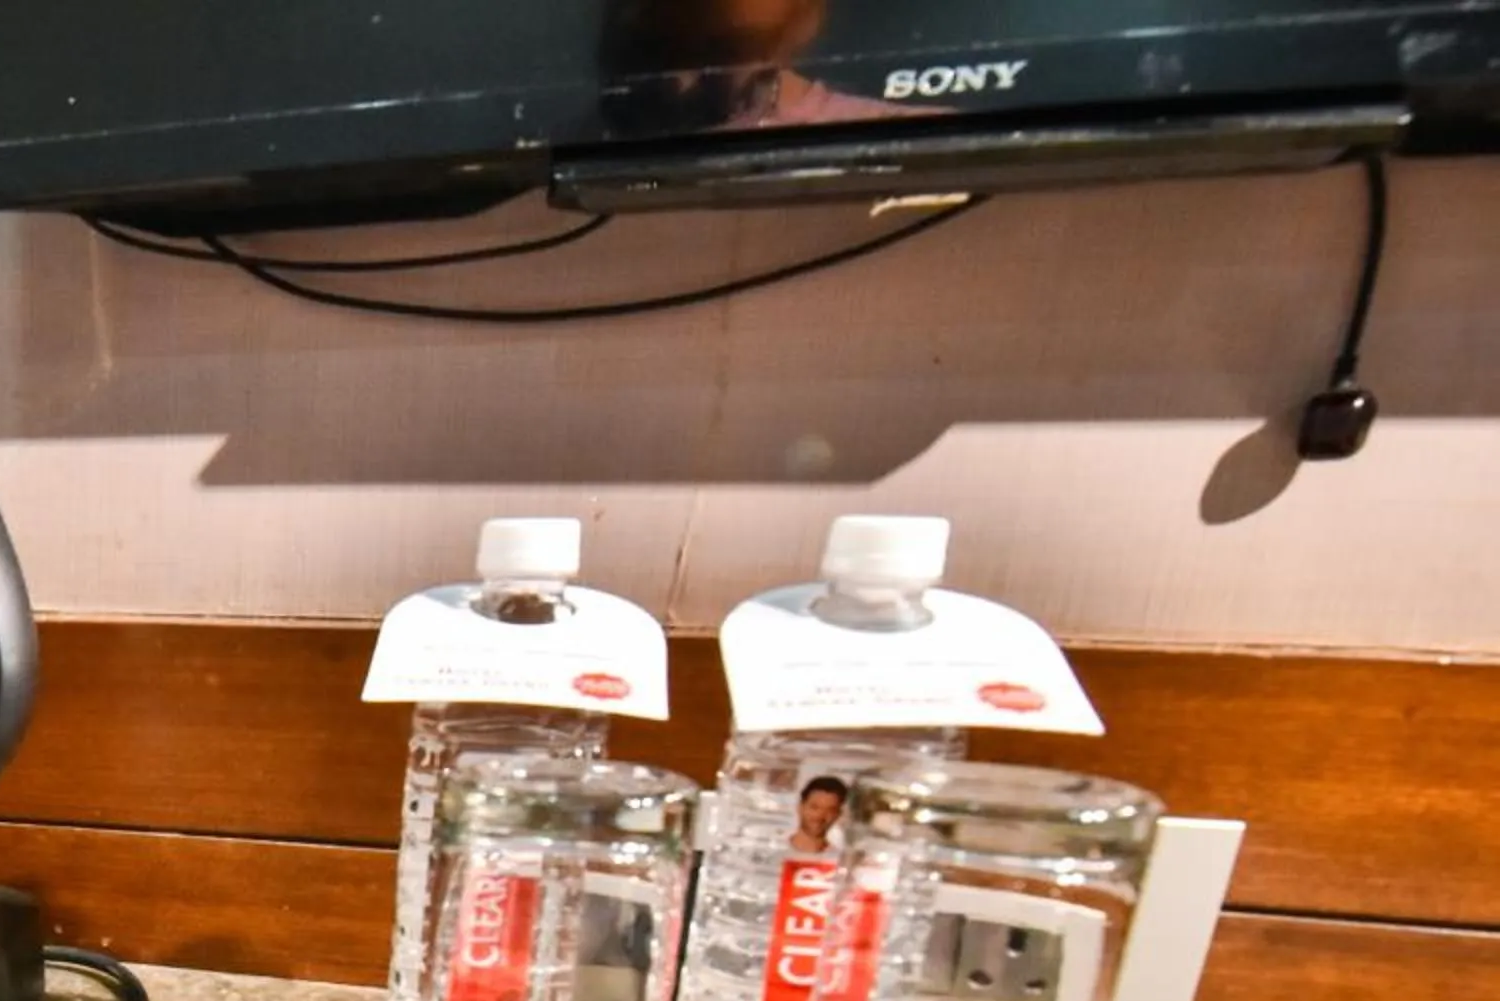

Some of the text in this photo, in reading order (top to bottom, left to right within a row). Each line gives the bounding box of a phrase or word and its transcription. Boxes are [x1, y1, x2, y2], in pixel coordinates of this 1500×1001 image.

[883, 60, 1029, 98] SONY
[461, 875, 509, 969] CLEAR
[777, 866, 837, 987] CLEAR
